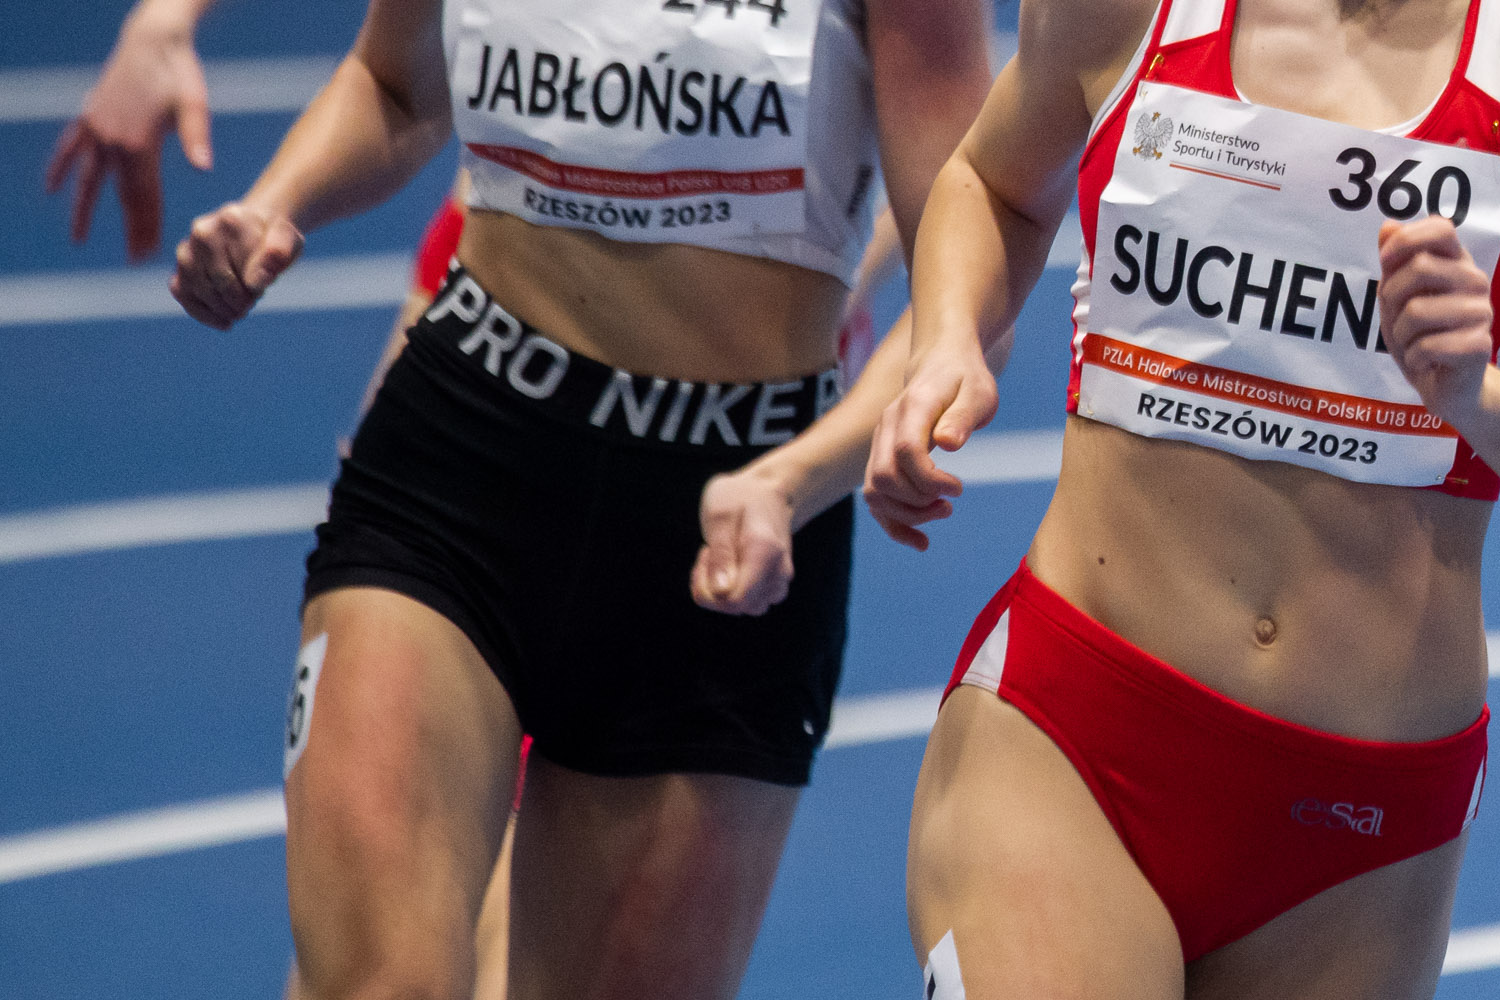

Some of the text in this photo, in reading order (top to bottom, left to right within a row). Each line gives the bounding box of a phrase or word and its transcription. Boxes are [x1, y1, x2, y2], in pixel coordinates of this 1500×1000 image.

[468, 45, 790, 138] JABŁOŃSKA
[1173, 140, 1286, 176] Sportu i Turystyki
[1178, 123, 1260, 151] Ministerstwo
[523, 186, 732, 229] RZESZÓW 2023
[1328, 147, 1472, 229] 360
[1110, 224, 1390, 354] SUCHEN
[424, 275, 571, 399] PRO
[590, 371, 804, 447] NIKE
[1103, 346, 1443, 430] PZLA Halowe Mistrzostwa Polski U18 U20
[1137, 392, 1379, 465] RZESZÓW 2023
